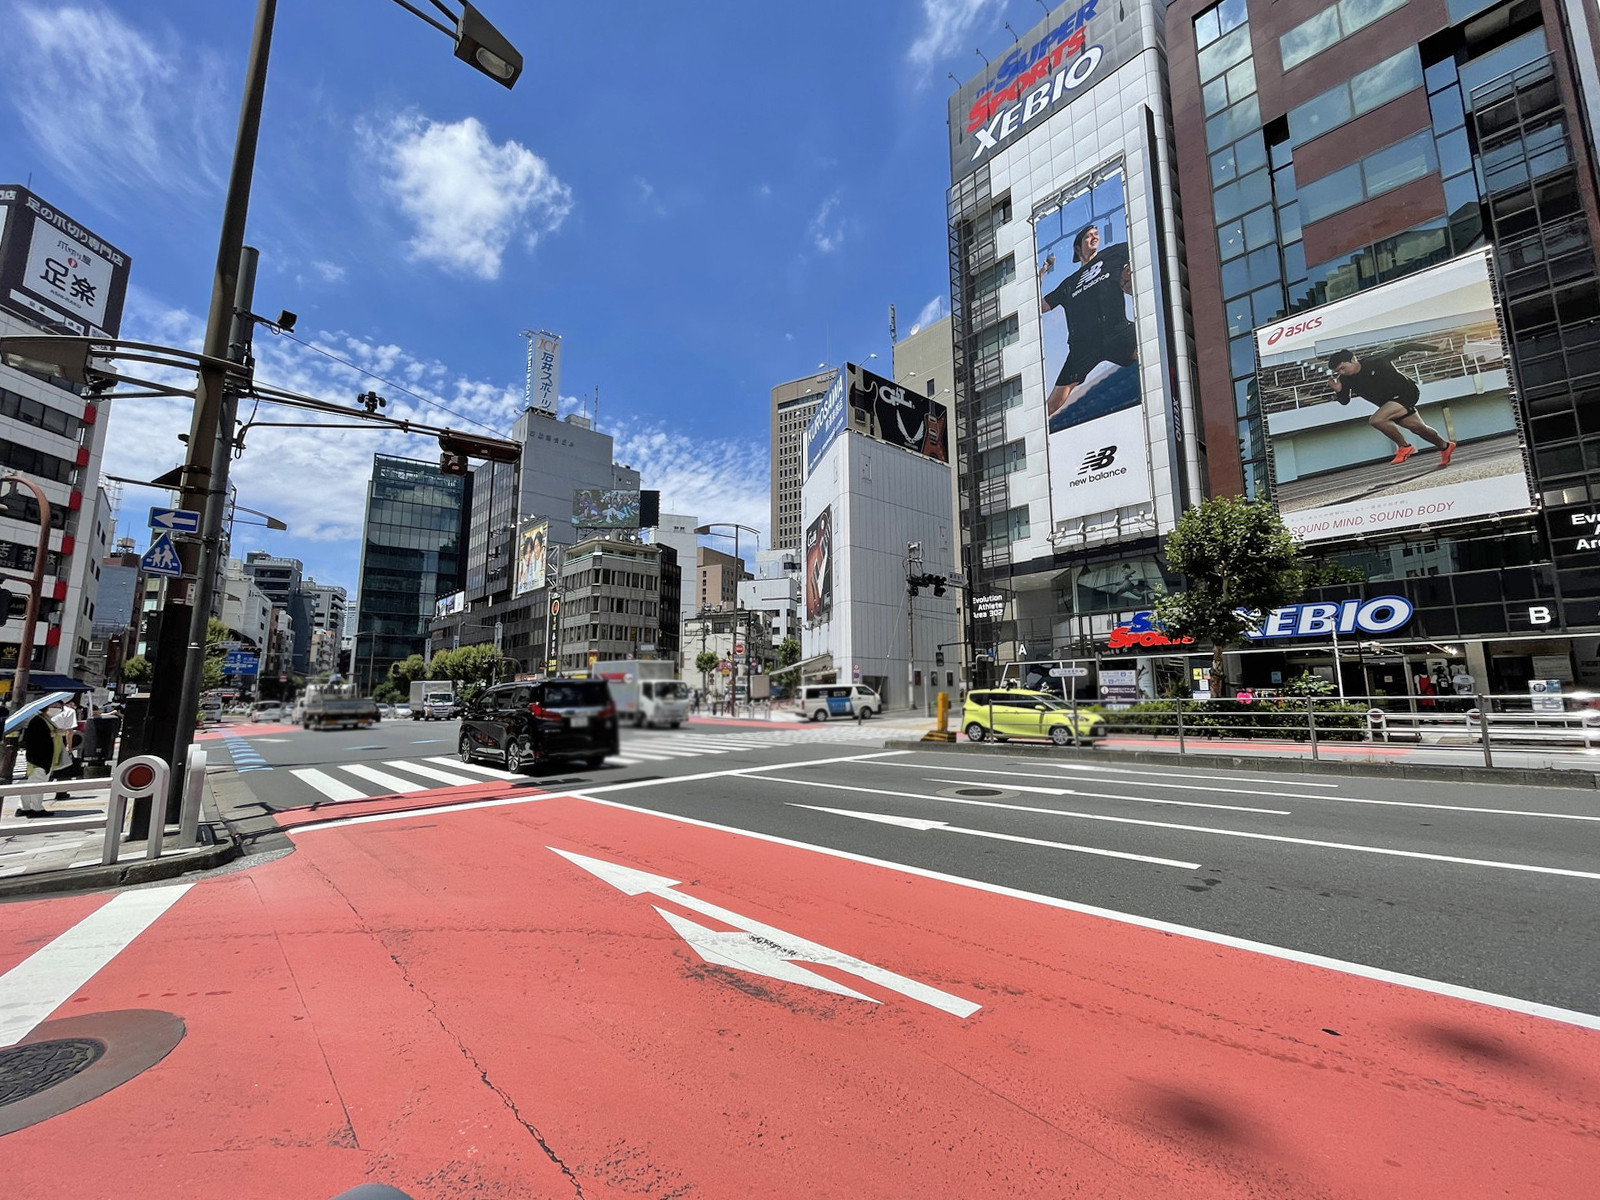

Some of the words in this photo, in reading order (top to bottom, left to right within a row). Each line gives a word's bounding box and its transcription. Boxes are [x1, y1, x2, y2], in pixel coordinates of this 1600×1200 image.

[996, 0, 1099, 92] SUPER
[966, 26, 1087, 133] SPORTS
[969, 44, 1104, 162] XEBIO
[25, 196, 124, 267] 足の爪切り専門店
[39, 257, 97, 307] 足楽
[1082, 272, 1111, 294] balance
[1285, 316, 1323, 338] asics
[538, 338, 558, 353] ICI
[540, 352, 555, 410] 石井スポーツ
[807, 375, 843, 446] KUROSAWA
[1069, 476, 1088, 488] new
[1088, 465, 1127, 483] balance
[1291, 521, 1330, 536] SOUND
[1332, 515, 1366, 530] MIND,
[1369, 508, 1414, 524] SOUND
[1417, 501, 1455, 516] BODY
[1571, 513, 1600, 525] Ev
[1576, 538, 1600, 550] Ar
[972, 594, 1002, 604] Evolution
[977, 603, 1003, 611] Athlete
[989, 609, 1004, 617] 302
[1528, 606, 1552, 625] B
[1018, 645, 1028, 656] A
